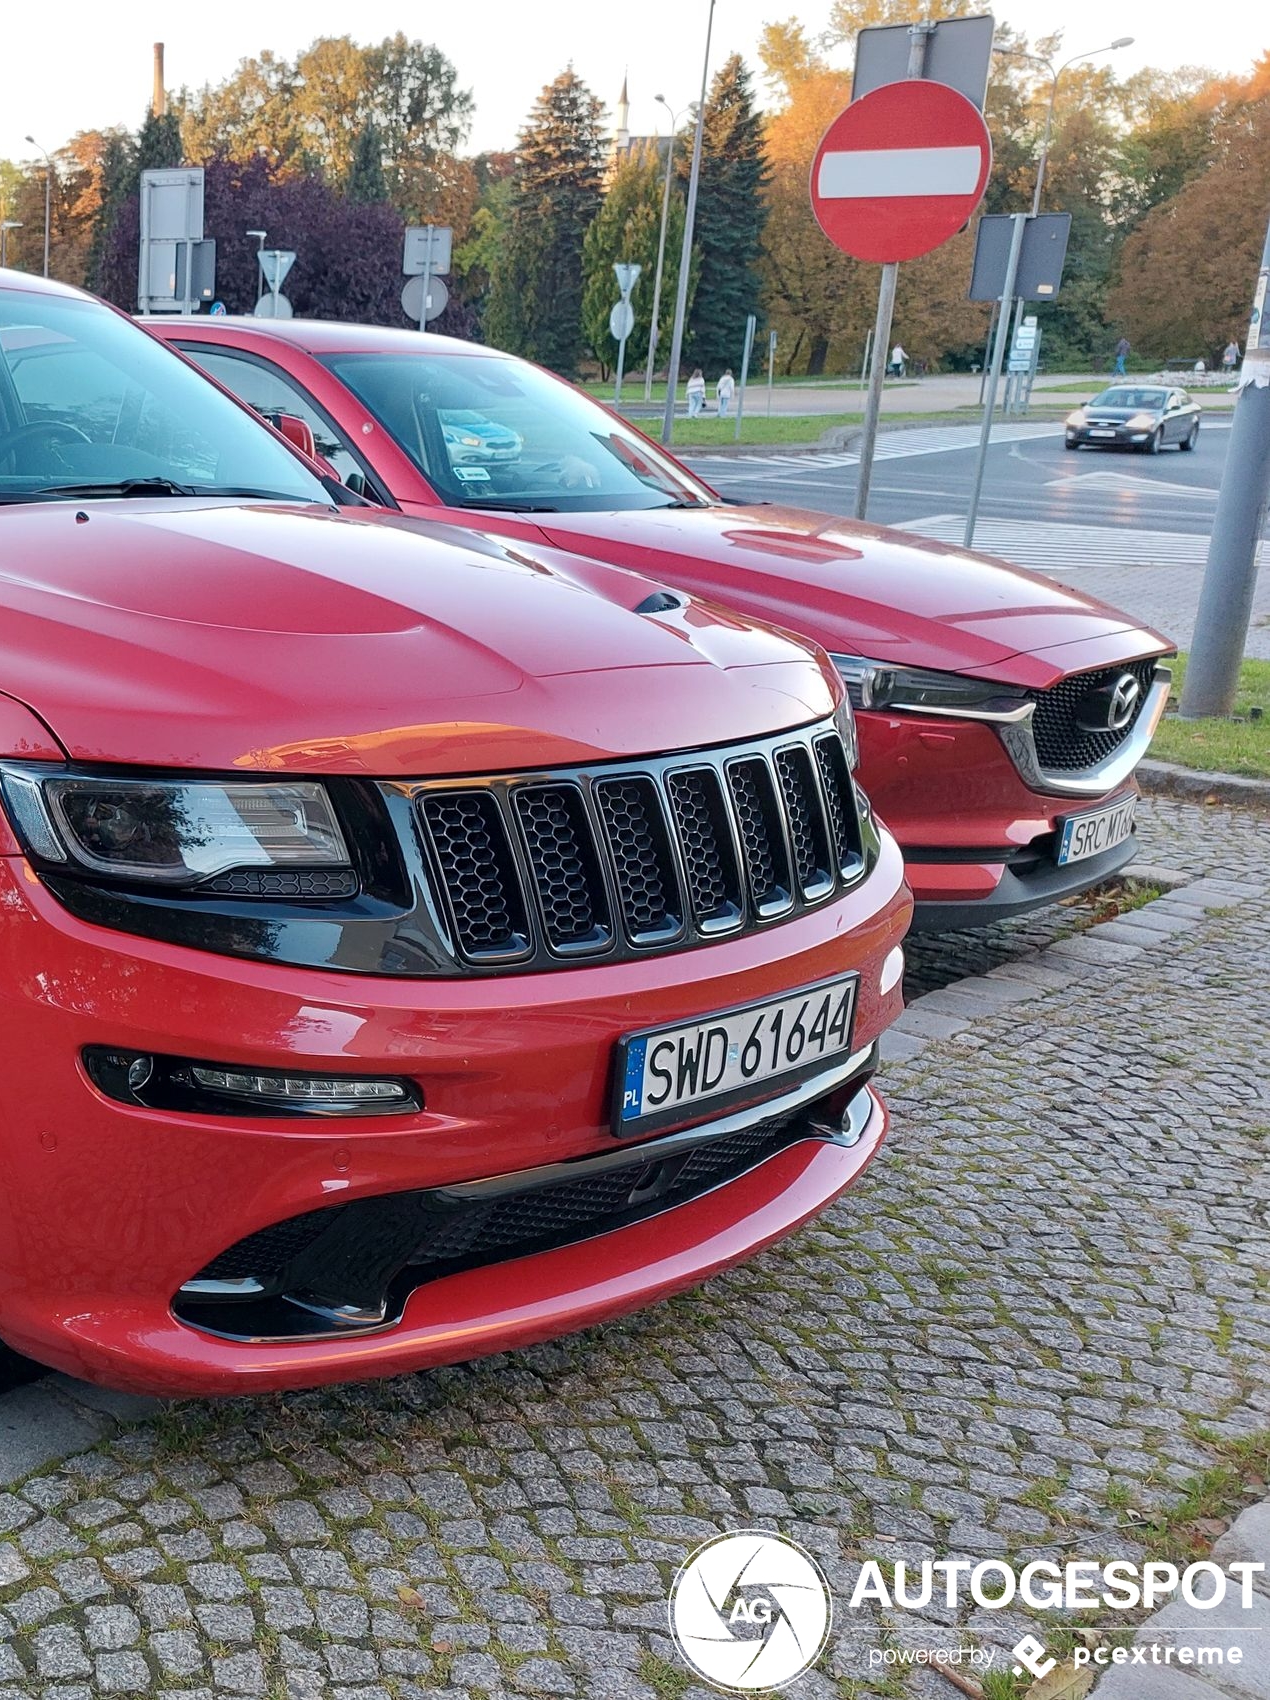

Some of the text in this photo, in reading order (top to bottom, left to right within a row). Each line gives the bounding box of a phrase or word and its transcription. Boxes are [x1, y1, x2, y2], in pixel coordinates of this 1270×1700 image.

[1073, 816, 1106, 857] SRC
[647, 986, 852, 1106] SWD 61644
[623, 1090, 639, 1109] PL
